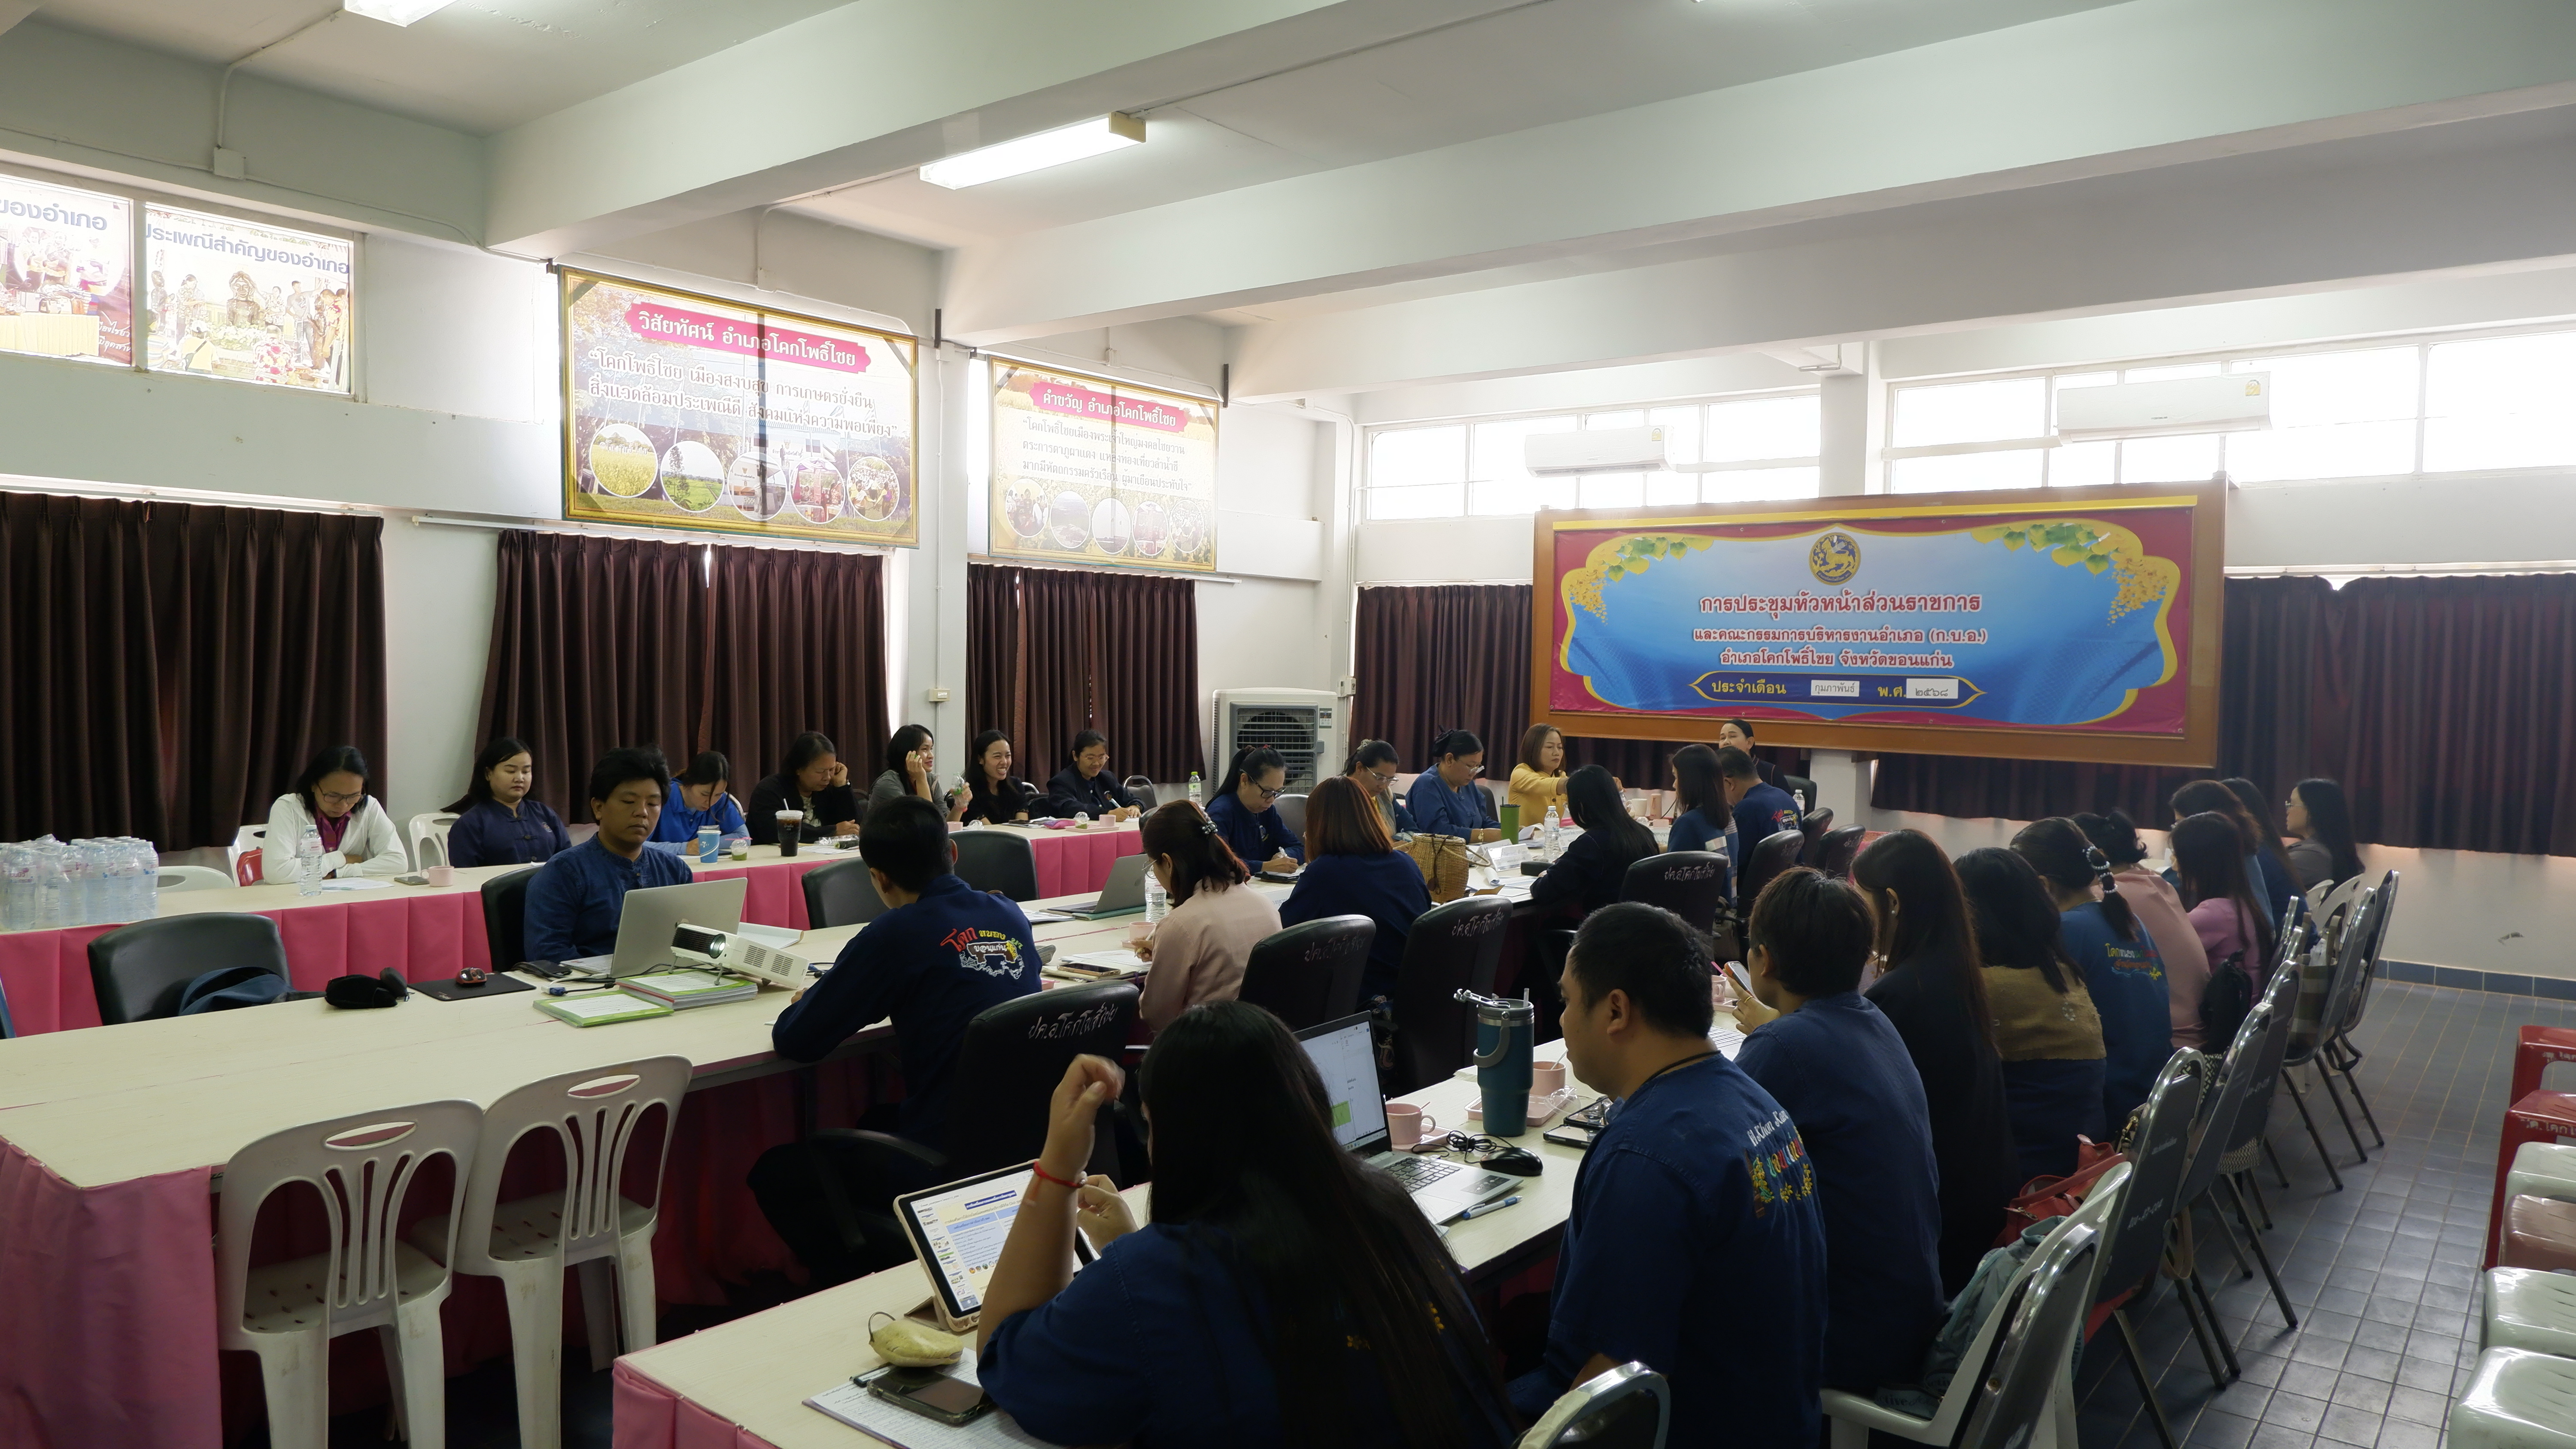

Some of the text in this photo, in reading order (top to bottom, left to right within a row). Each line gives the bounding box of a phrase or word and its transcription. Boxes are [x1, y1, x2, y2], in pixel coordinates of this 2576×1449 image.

[638, 311, 856, 366] วิสัยทัศน์ อำเภอโคกโพธิ์ไชย
[589, 376, 741, 416] สิ่งแวดล้อมประเพณีดี
[689, 366, 769, 396] เมืองสงบสุข
[777, 384, 873, 409] การเกษตรยั่งยืน
[1043, 389, 1176, 427] คำขวัญ อำเภอโคกโพธิ์ไชย
[1701, 590, 1981, 619] การประชุมหัวหน้าส่วนราชการ
[1694, 626, 1987, 644] และคณะกรรมการบริหารงานอำเภอ (ก.บ.อ.)
[1721, 645, 1954, 668] อำเภอโคกโพธิ์ไชย จังหวัดขอนแก่น
[1712, 679, 1949, 697] ประจำเดือน กุมภาพันธ์ พ.ศ. ๒๕๖๘
[940, 927, 978, 952] โคก
[978, 930, 1006, 940] หนอง
[974, 944, 1007, 953] ขอนแก่น
